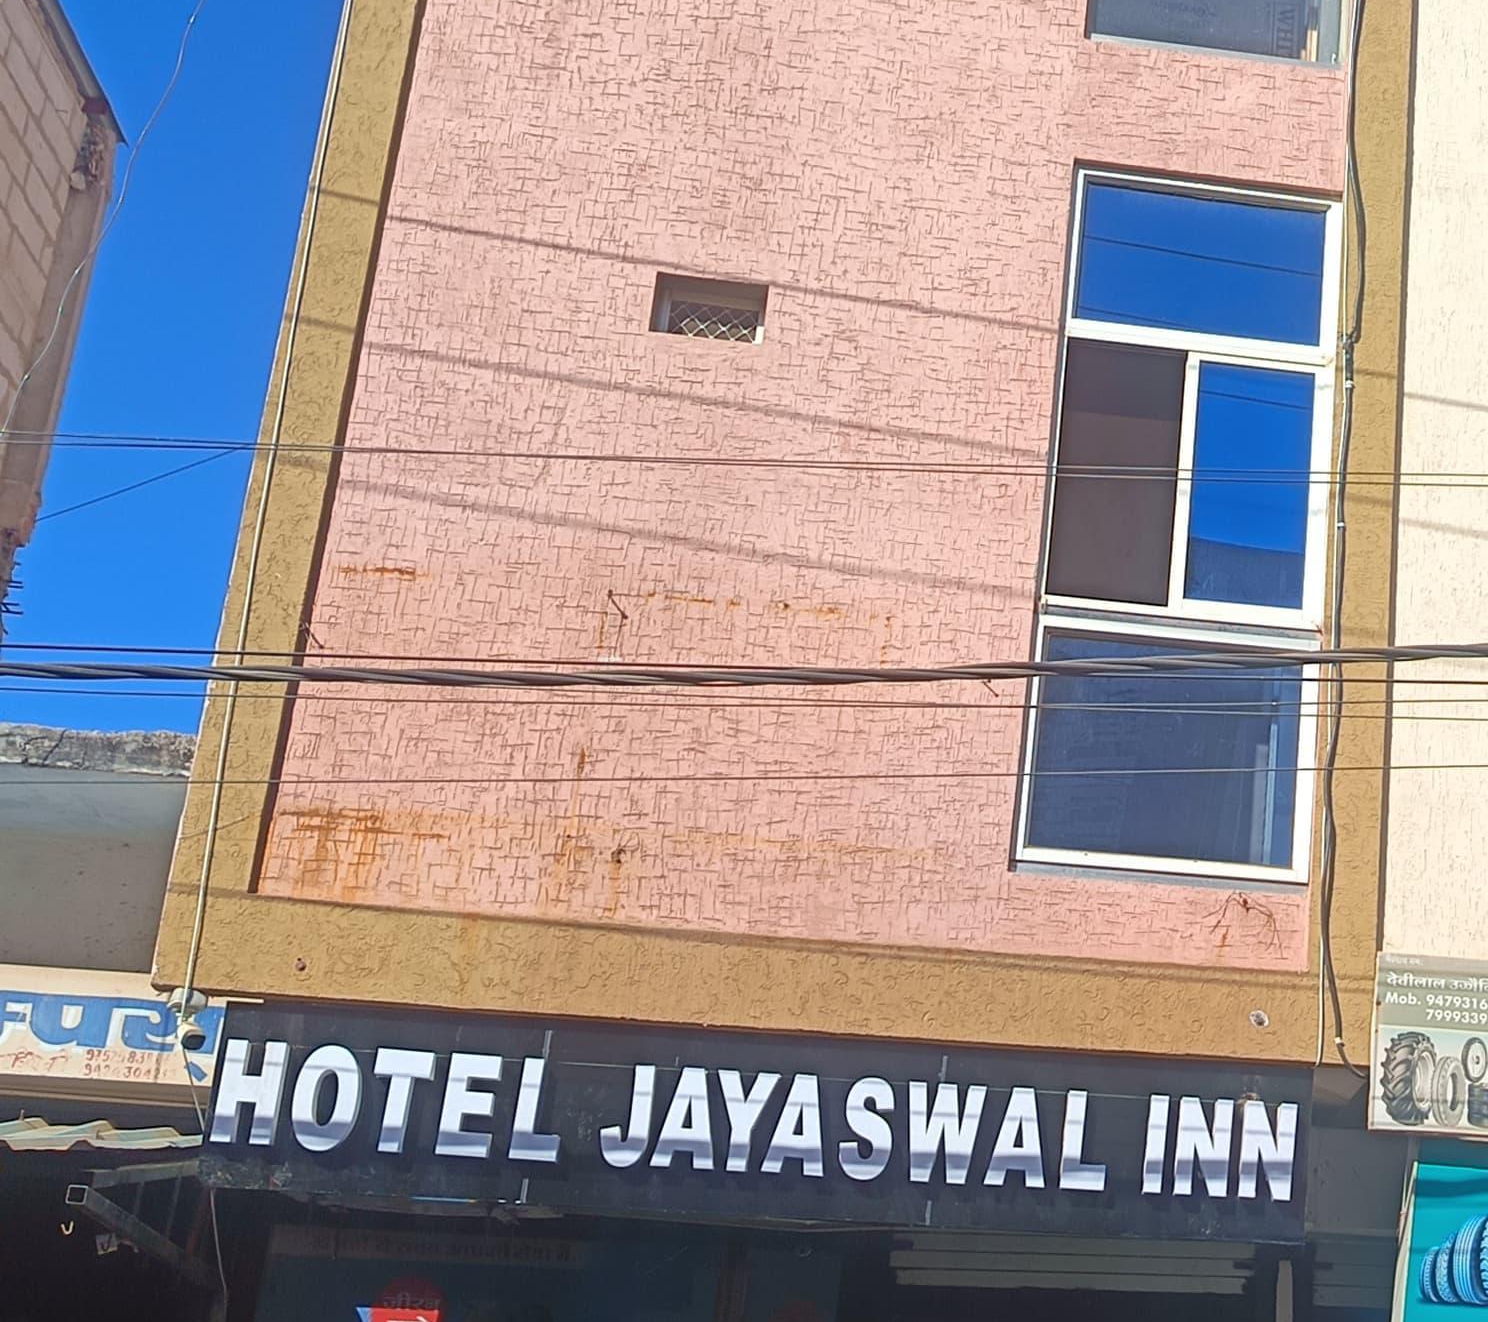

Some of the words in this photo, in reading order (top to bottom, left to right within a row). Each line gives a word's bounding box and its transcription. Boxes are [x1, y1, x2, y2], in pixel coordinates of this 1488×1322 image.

[1385, 991, 1422, 1006] Mob.
[208, 1037, 561, 1164] HOTEL
[599, 1063, 1108, 1192] JAYASWAL
[1142, 1093, 1298, 1203] INN
